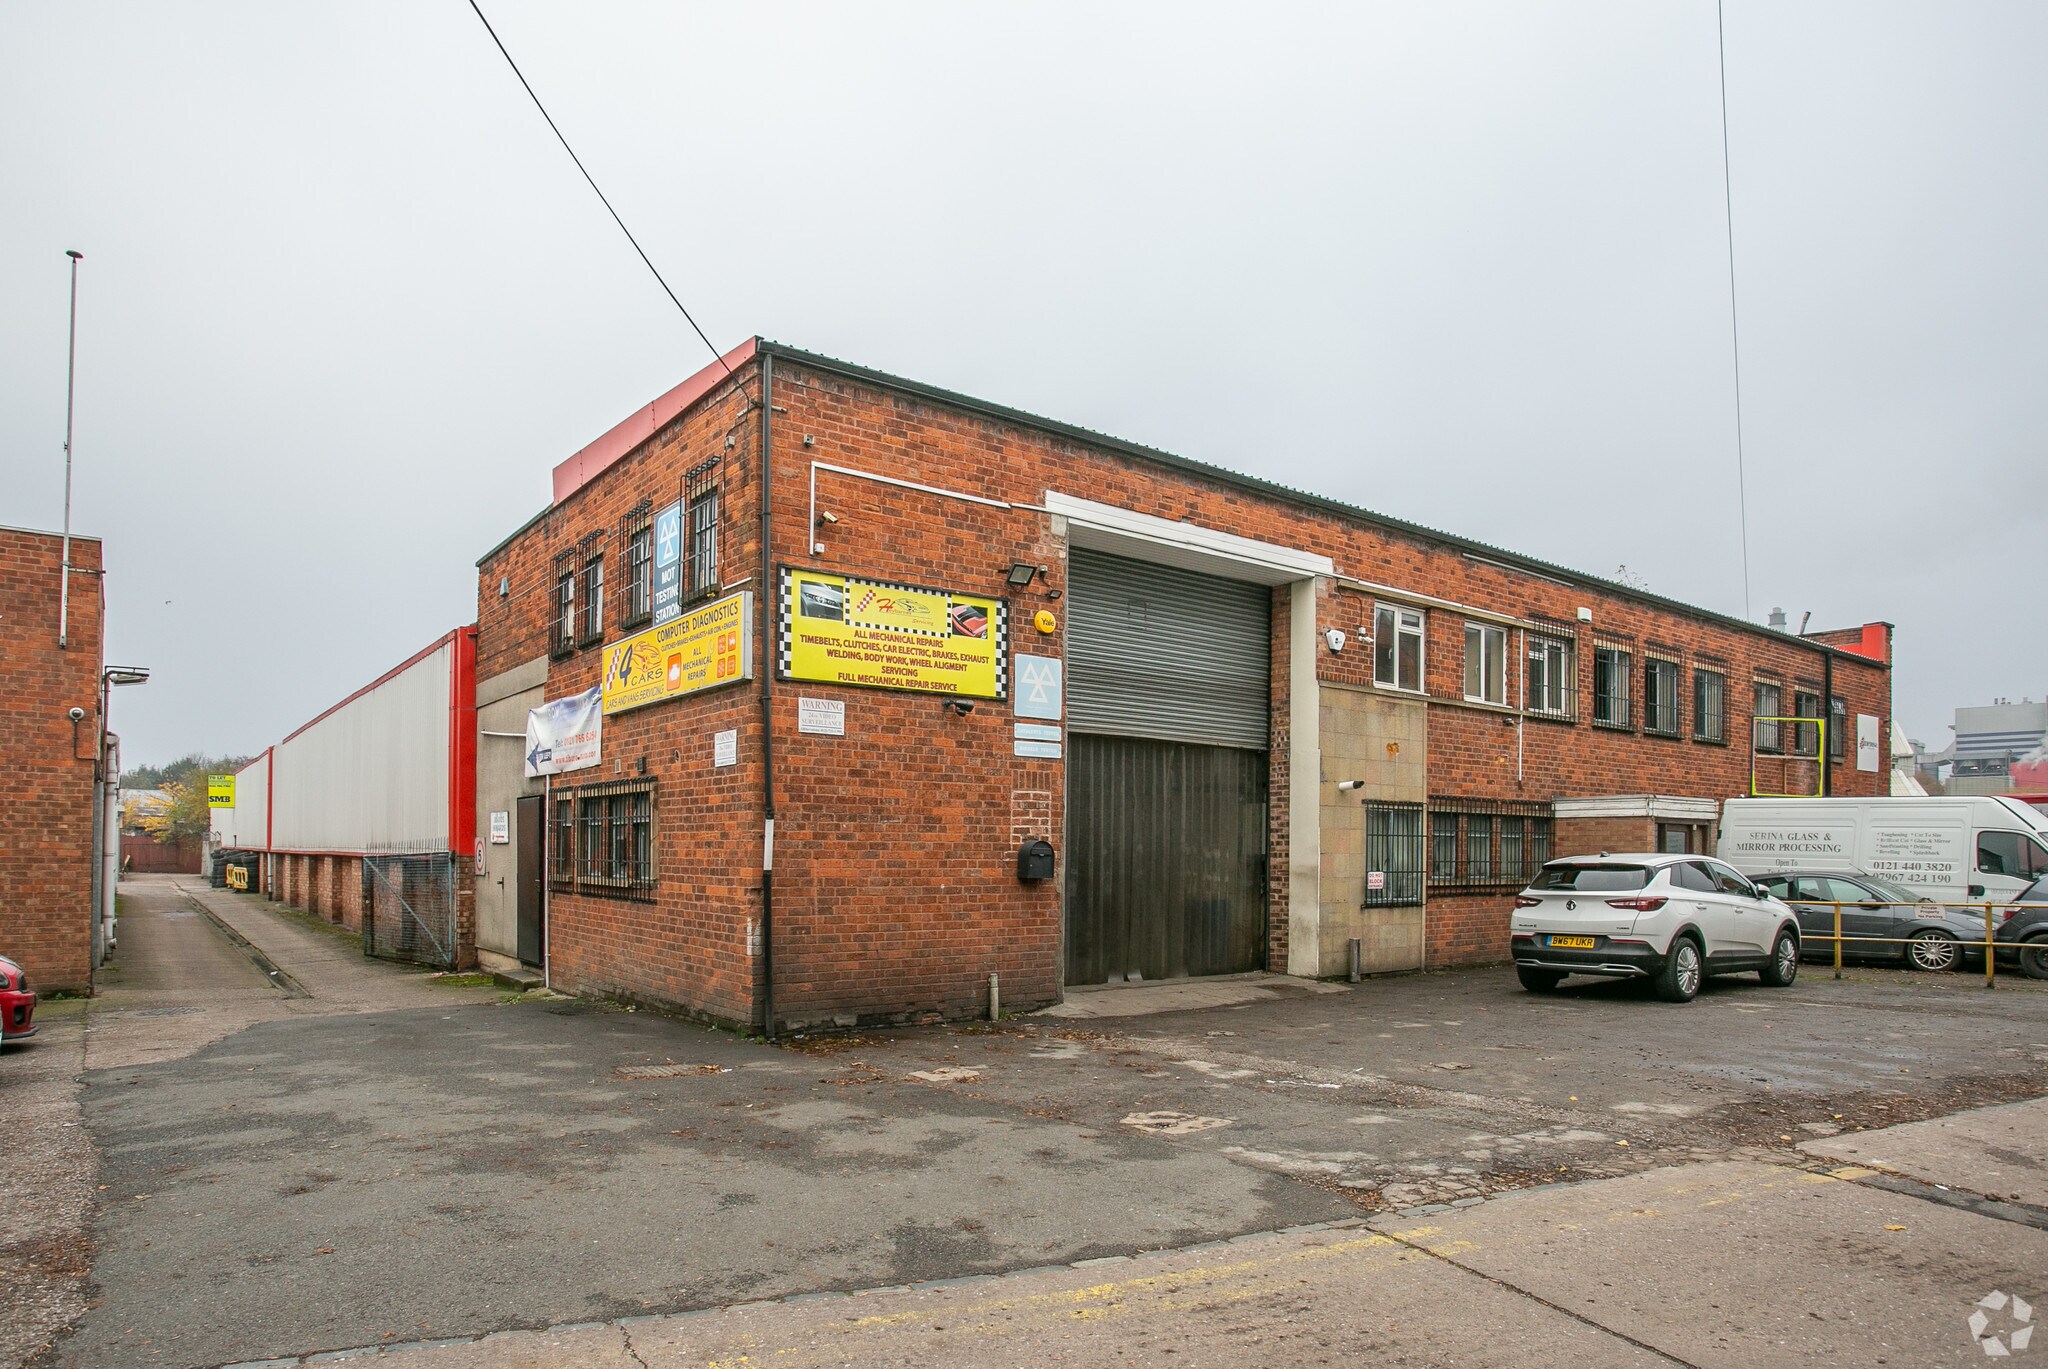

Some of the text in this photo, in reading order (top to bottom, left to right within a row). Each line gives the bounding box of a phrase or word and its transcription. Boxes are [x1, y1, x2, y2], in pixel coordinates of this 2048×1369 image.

[661, 566, 676, 584] MOT
[656, 602, 680, 623] STATION
[657, 601, 738, 643] COMPUTER DIAGNOSTICS
[1041, 618, 1054, 626] Yale
[854, 630, 944, 648] ALL MECHANICAL REPAIRS
[693, 647, 701, 656] ALL
[800, 634, 989, 664] TIMEBELTS, CLUTCHES, CAR ELECTRIC, BRAKES, EXHAUST
[619, 644, 633, 687] 4
[682, 656, 712, 671] MECHANICAL
[826, 649, 968, 672] WELDING, BODY WORK, WHEEL ALIGMENT
[631, 668, 663, 686] CARS
[687, 669, 706, 681] REPAIRS
[881, 666, 918, 677] SERVICING
[838, 672, 957, 691] FULL MECHANICAL REPAIR SERVICE
[606, 697, 618, 709] CARS
[640, 684, 665, 700] SERVICING
[802, 700, 842, 711] WARNING
[1749, 832, 1831, 841] SERINA GLASS &
[1736, 843, 1841, 853] MIRROR PROCESSING
[1775, 859, 1790, 868] Open
[1873, 862, 1952, 871] 0121 440 3820
[1873, 872, 1951, 883] 07967 424 190
[1552, 937, 1593, 946] BW67 UKR
